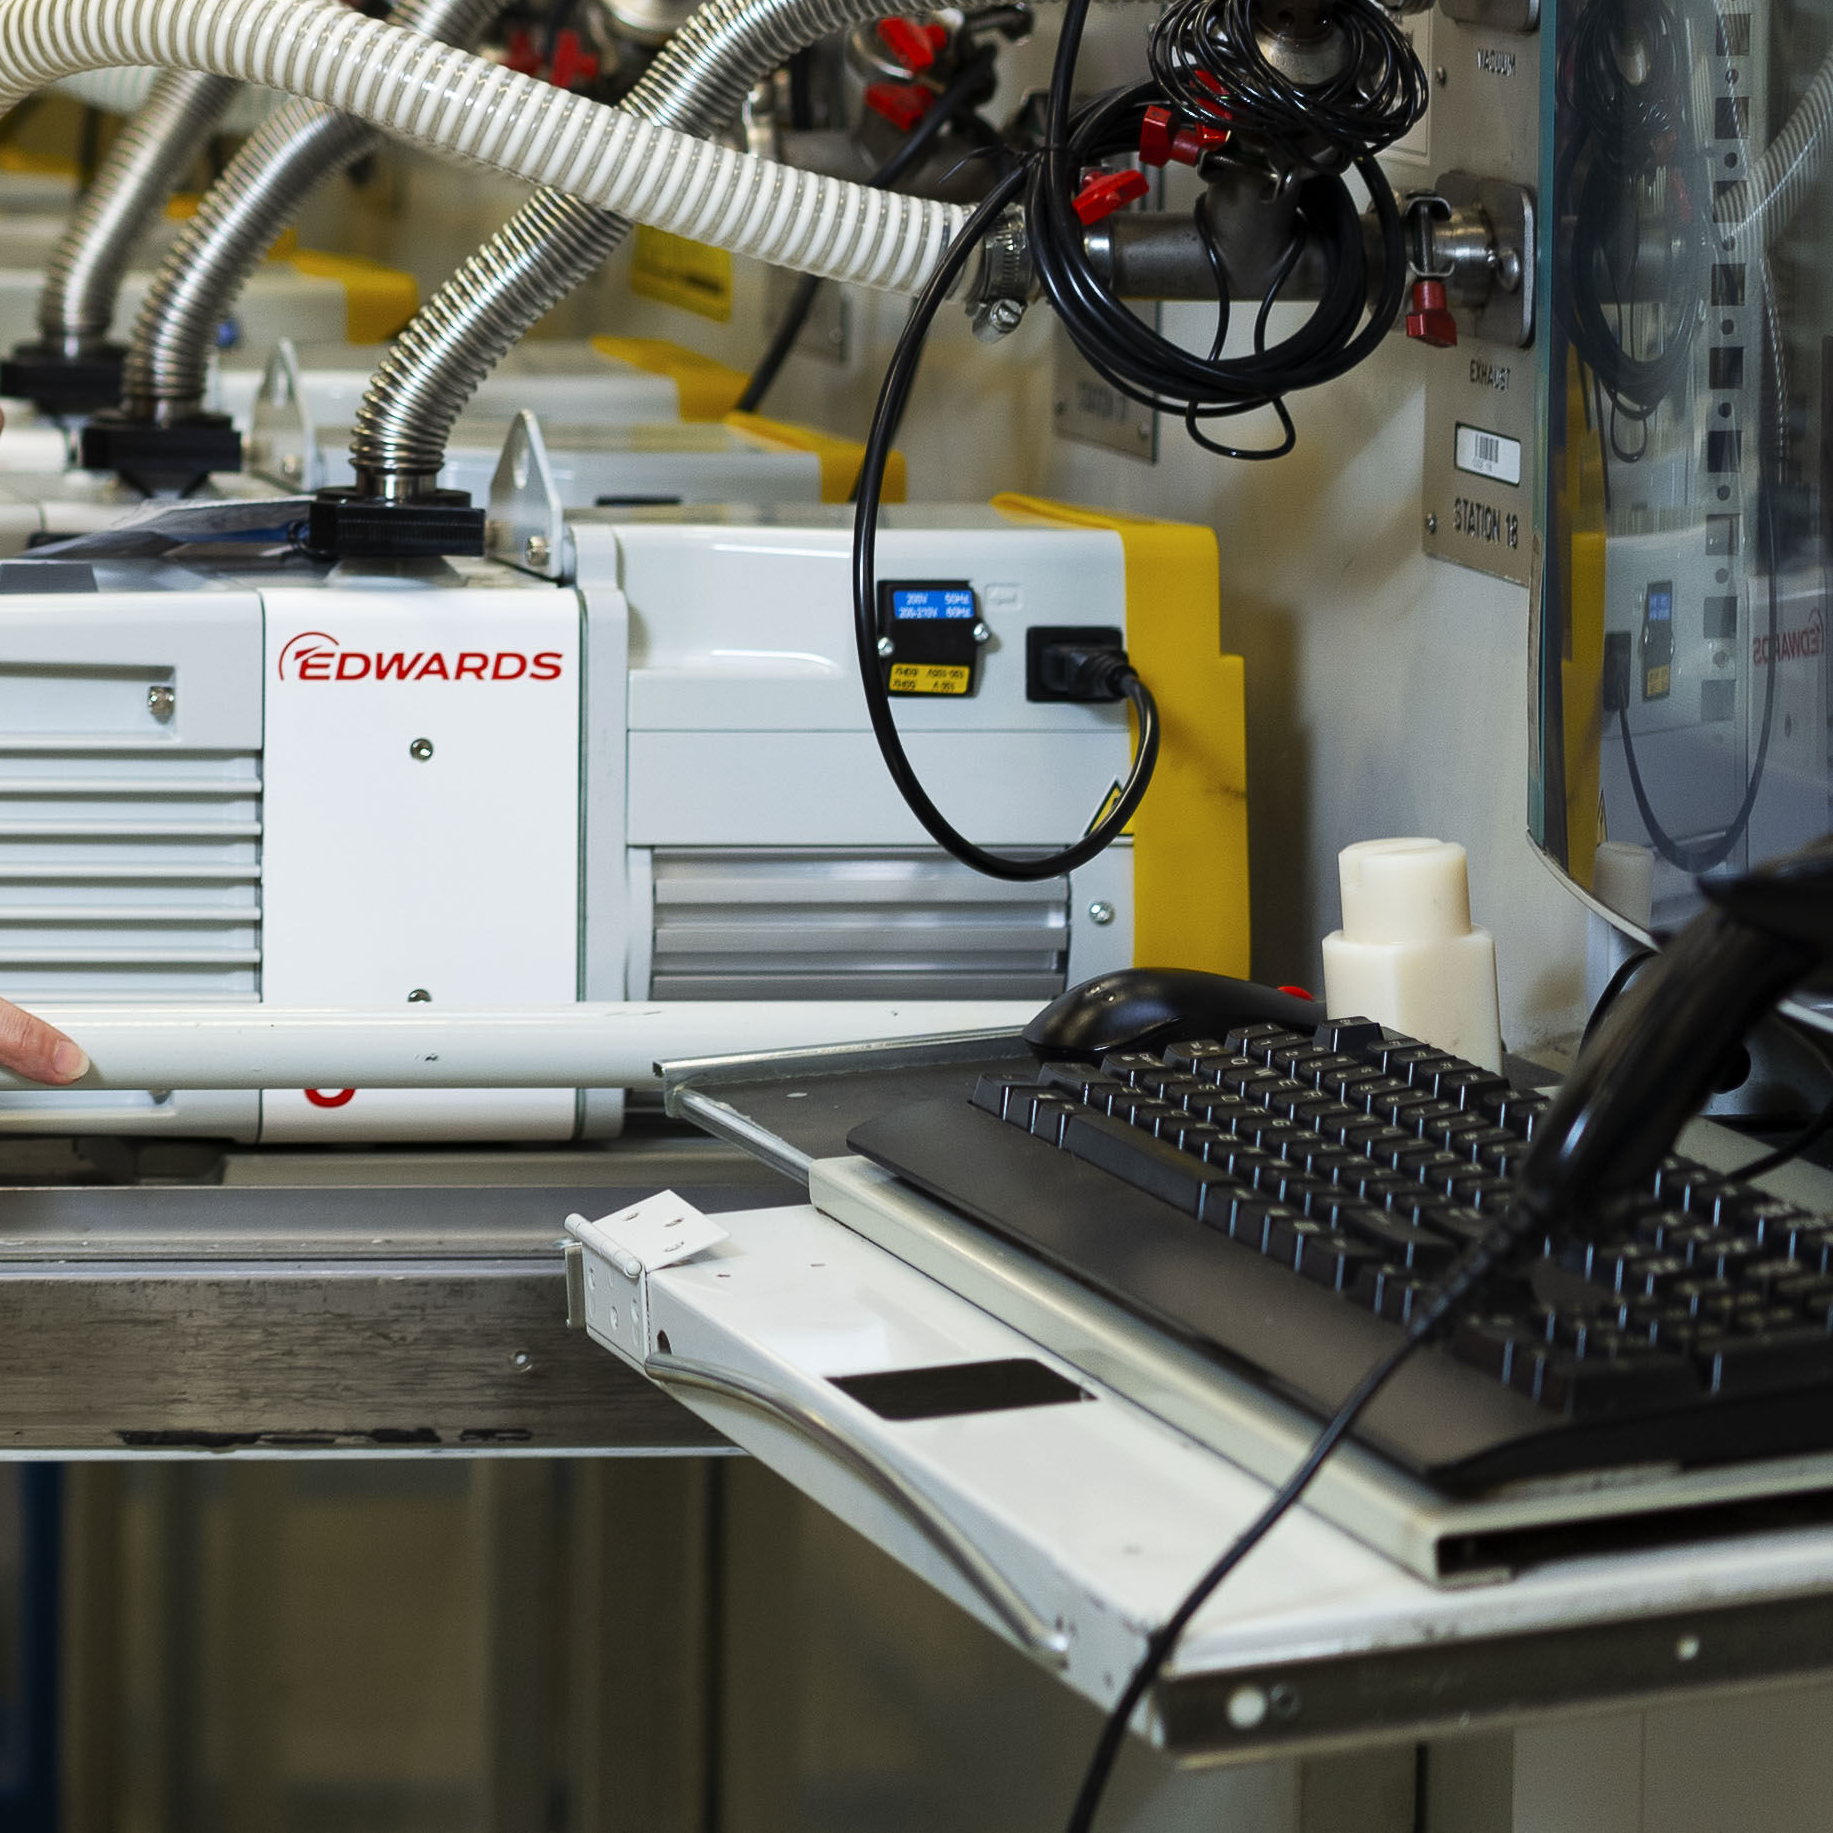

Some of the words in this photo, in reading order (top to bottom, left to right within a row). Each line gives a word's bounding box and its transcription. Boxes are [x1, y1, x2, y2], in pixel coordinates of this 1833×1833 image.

[1469, 359, 1511, 391] EXHAUST
[1453, 497, 1501, 544] STATION
[1505, 513, 1519, 551] 18
[291, 640, 564, 681] EDWARDS
